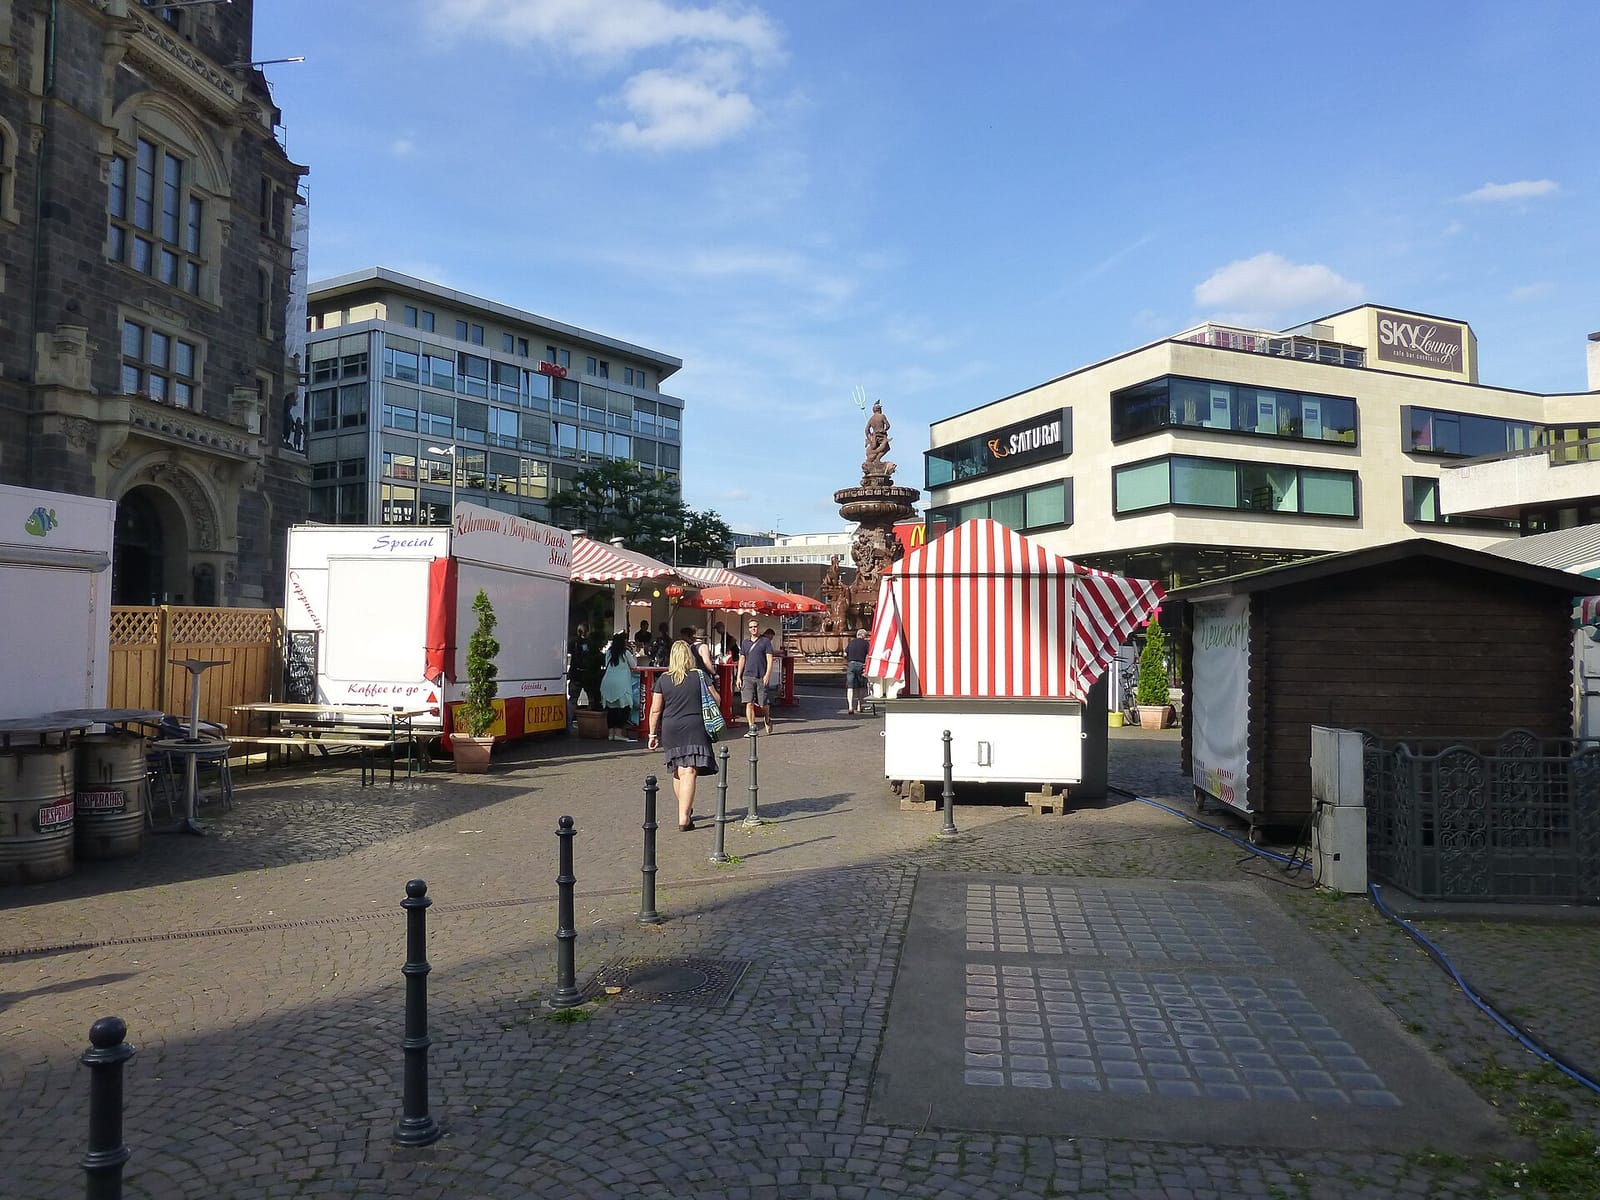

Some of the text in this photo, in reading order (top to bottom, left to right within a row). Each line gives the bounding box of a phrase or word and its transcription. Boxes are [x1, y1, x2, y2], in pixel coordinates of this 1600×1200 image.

[1379, 319, 1459, 364] SKY Lounge
[1009, 421, 1060, 455] SATURN
[509, 515, 541, 543] Bergische
[372, 535, 434, 552] Special
[289, 571, 324, 634] Cappuccino
[347, 683, 418, 697] Kaffee to go
[527, 705, 565, 724] CREPES
